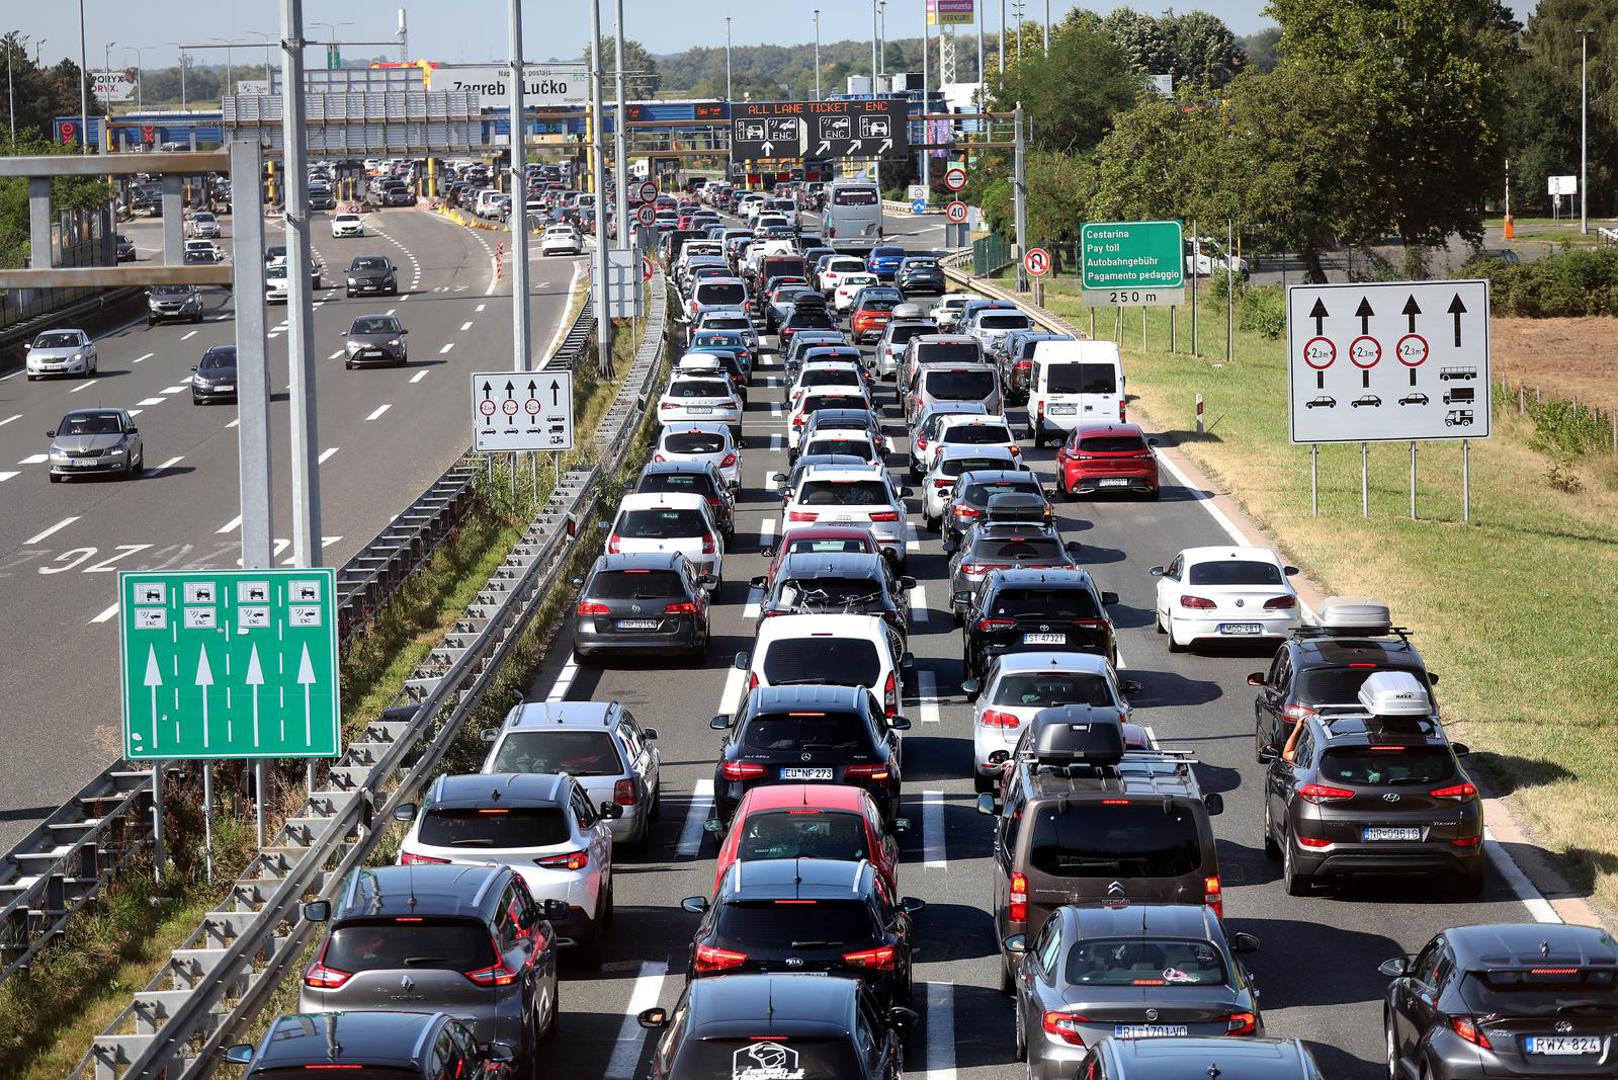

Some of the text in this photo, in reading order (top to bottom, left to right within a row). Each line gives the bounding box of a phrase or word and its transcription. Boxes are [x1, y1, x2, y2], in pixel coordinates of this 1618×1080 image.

[523, 80, 568, 95] Lučko
[749, 104, 770, 114] ALL
[774, 104, 804, 114] LANE
[808, 102, 849, 112] TICKET
[866, 101, 888, 112] ENC
[773, 132, 792, 140] ENC
[826, 130, 845, 138] ENC
[642, 210, 653, 220] 40
[951, 207, 963, 218] 40
[1086, 230, 1129, 239] Cestarina
[1087, 243, 1120, 254] Pay toll
[1088, 256, 1158, 268] Autobahngebühr
[1088, 270, 1179, 282] Pagamento pedaggio
[1110, 292, 1156, 302] 250 m
[786, 768, 832, 778] EU NF 273
